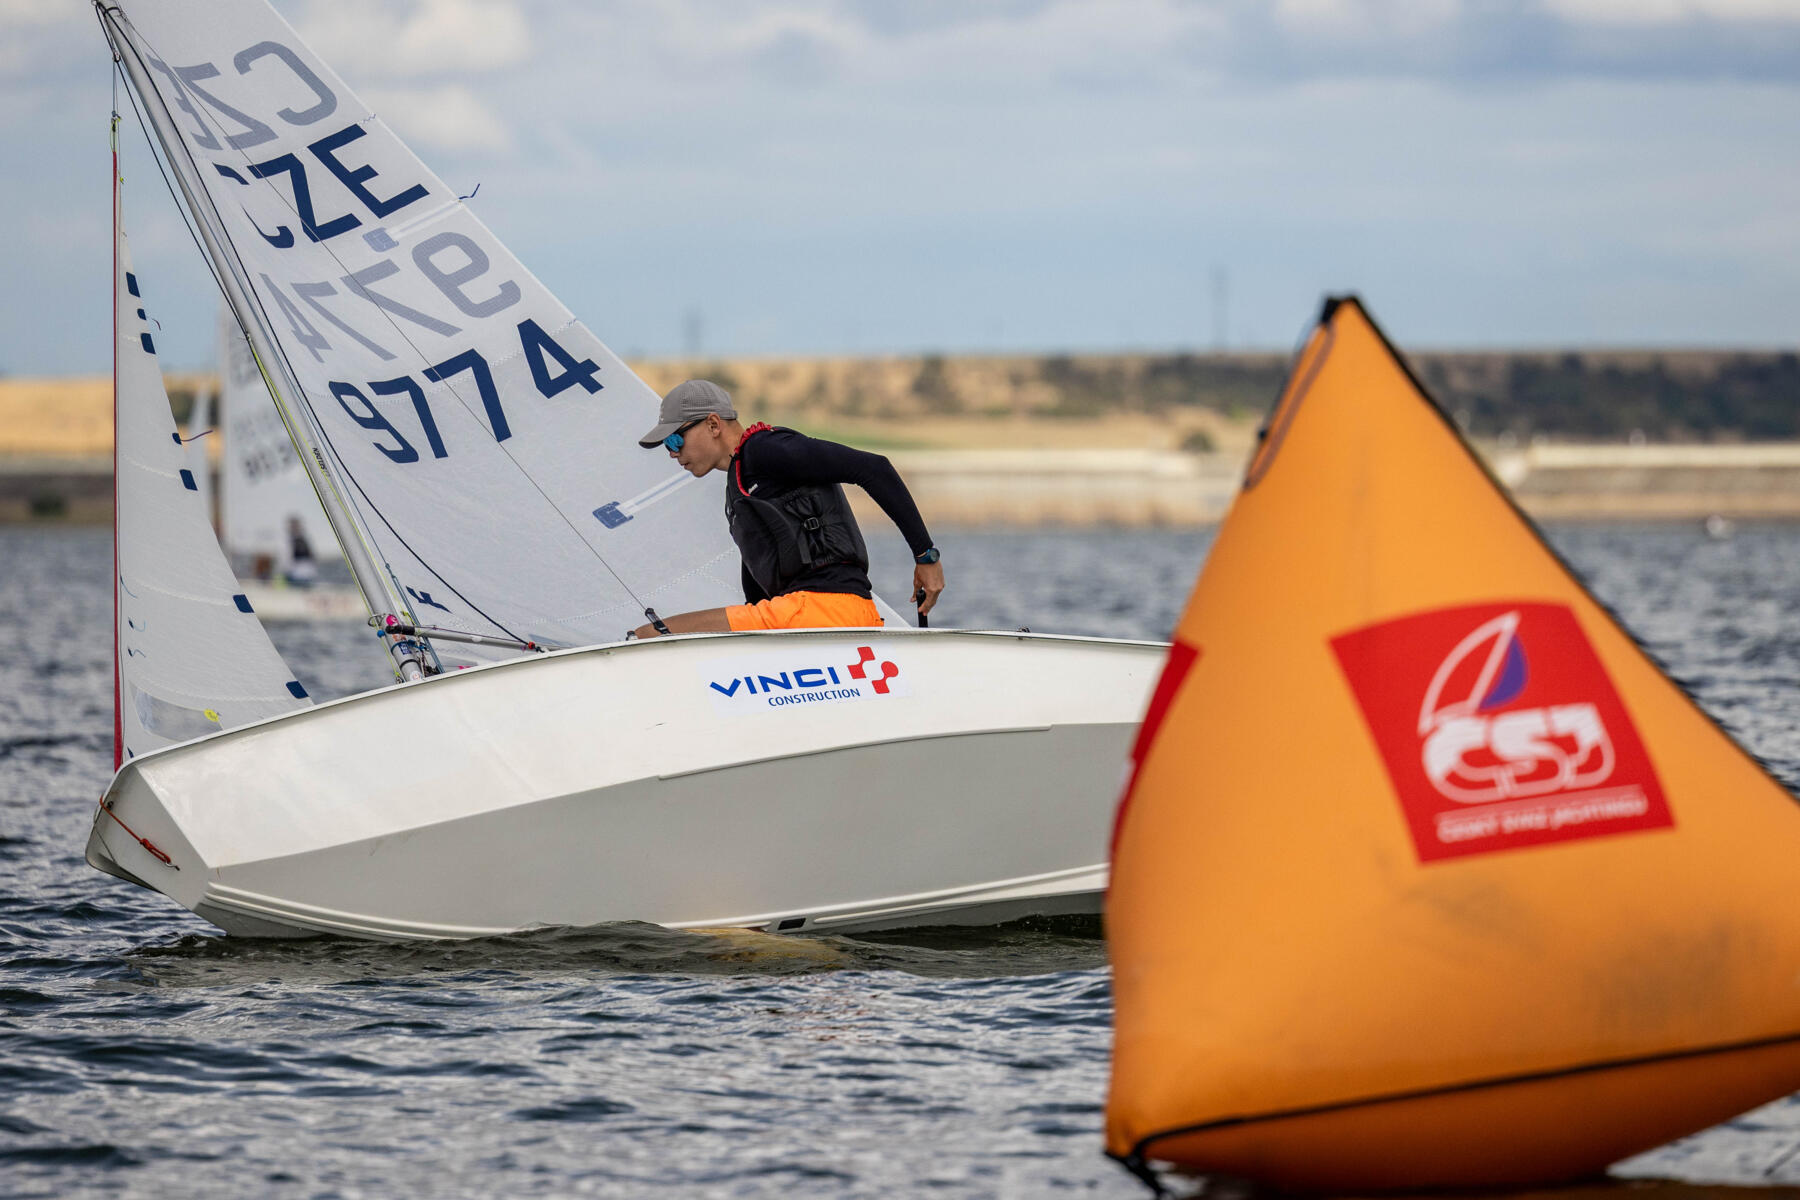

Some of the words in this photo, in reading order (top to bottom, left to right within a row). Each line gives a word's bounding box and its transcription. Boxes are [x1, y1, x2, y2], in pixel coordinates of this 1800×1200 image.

[328, 318, 604, 463] 9774
[710, 667, 841, 698] VINCI
[769, 688, 861, 707] CONSTRUCTION
